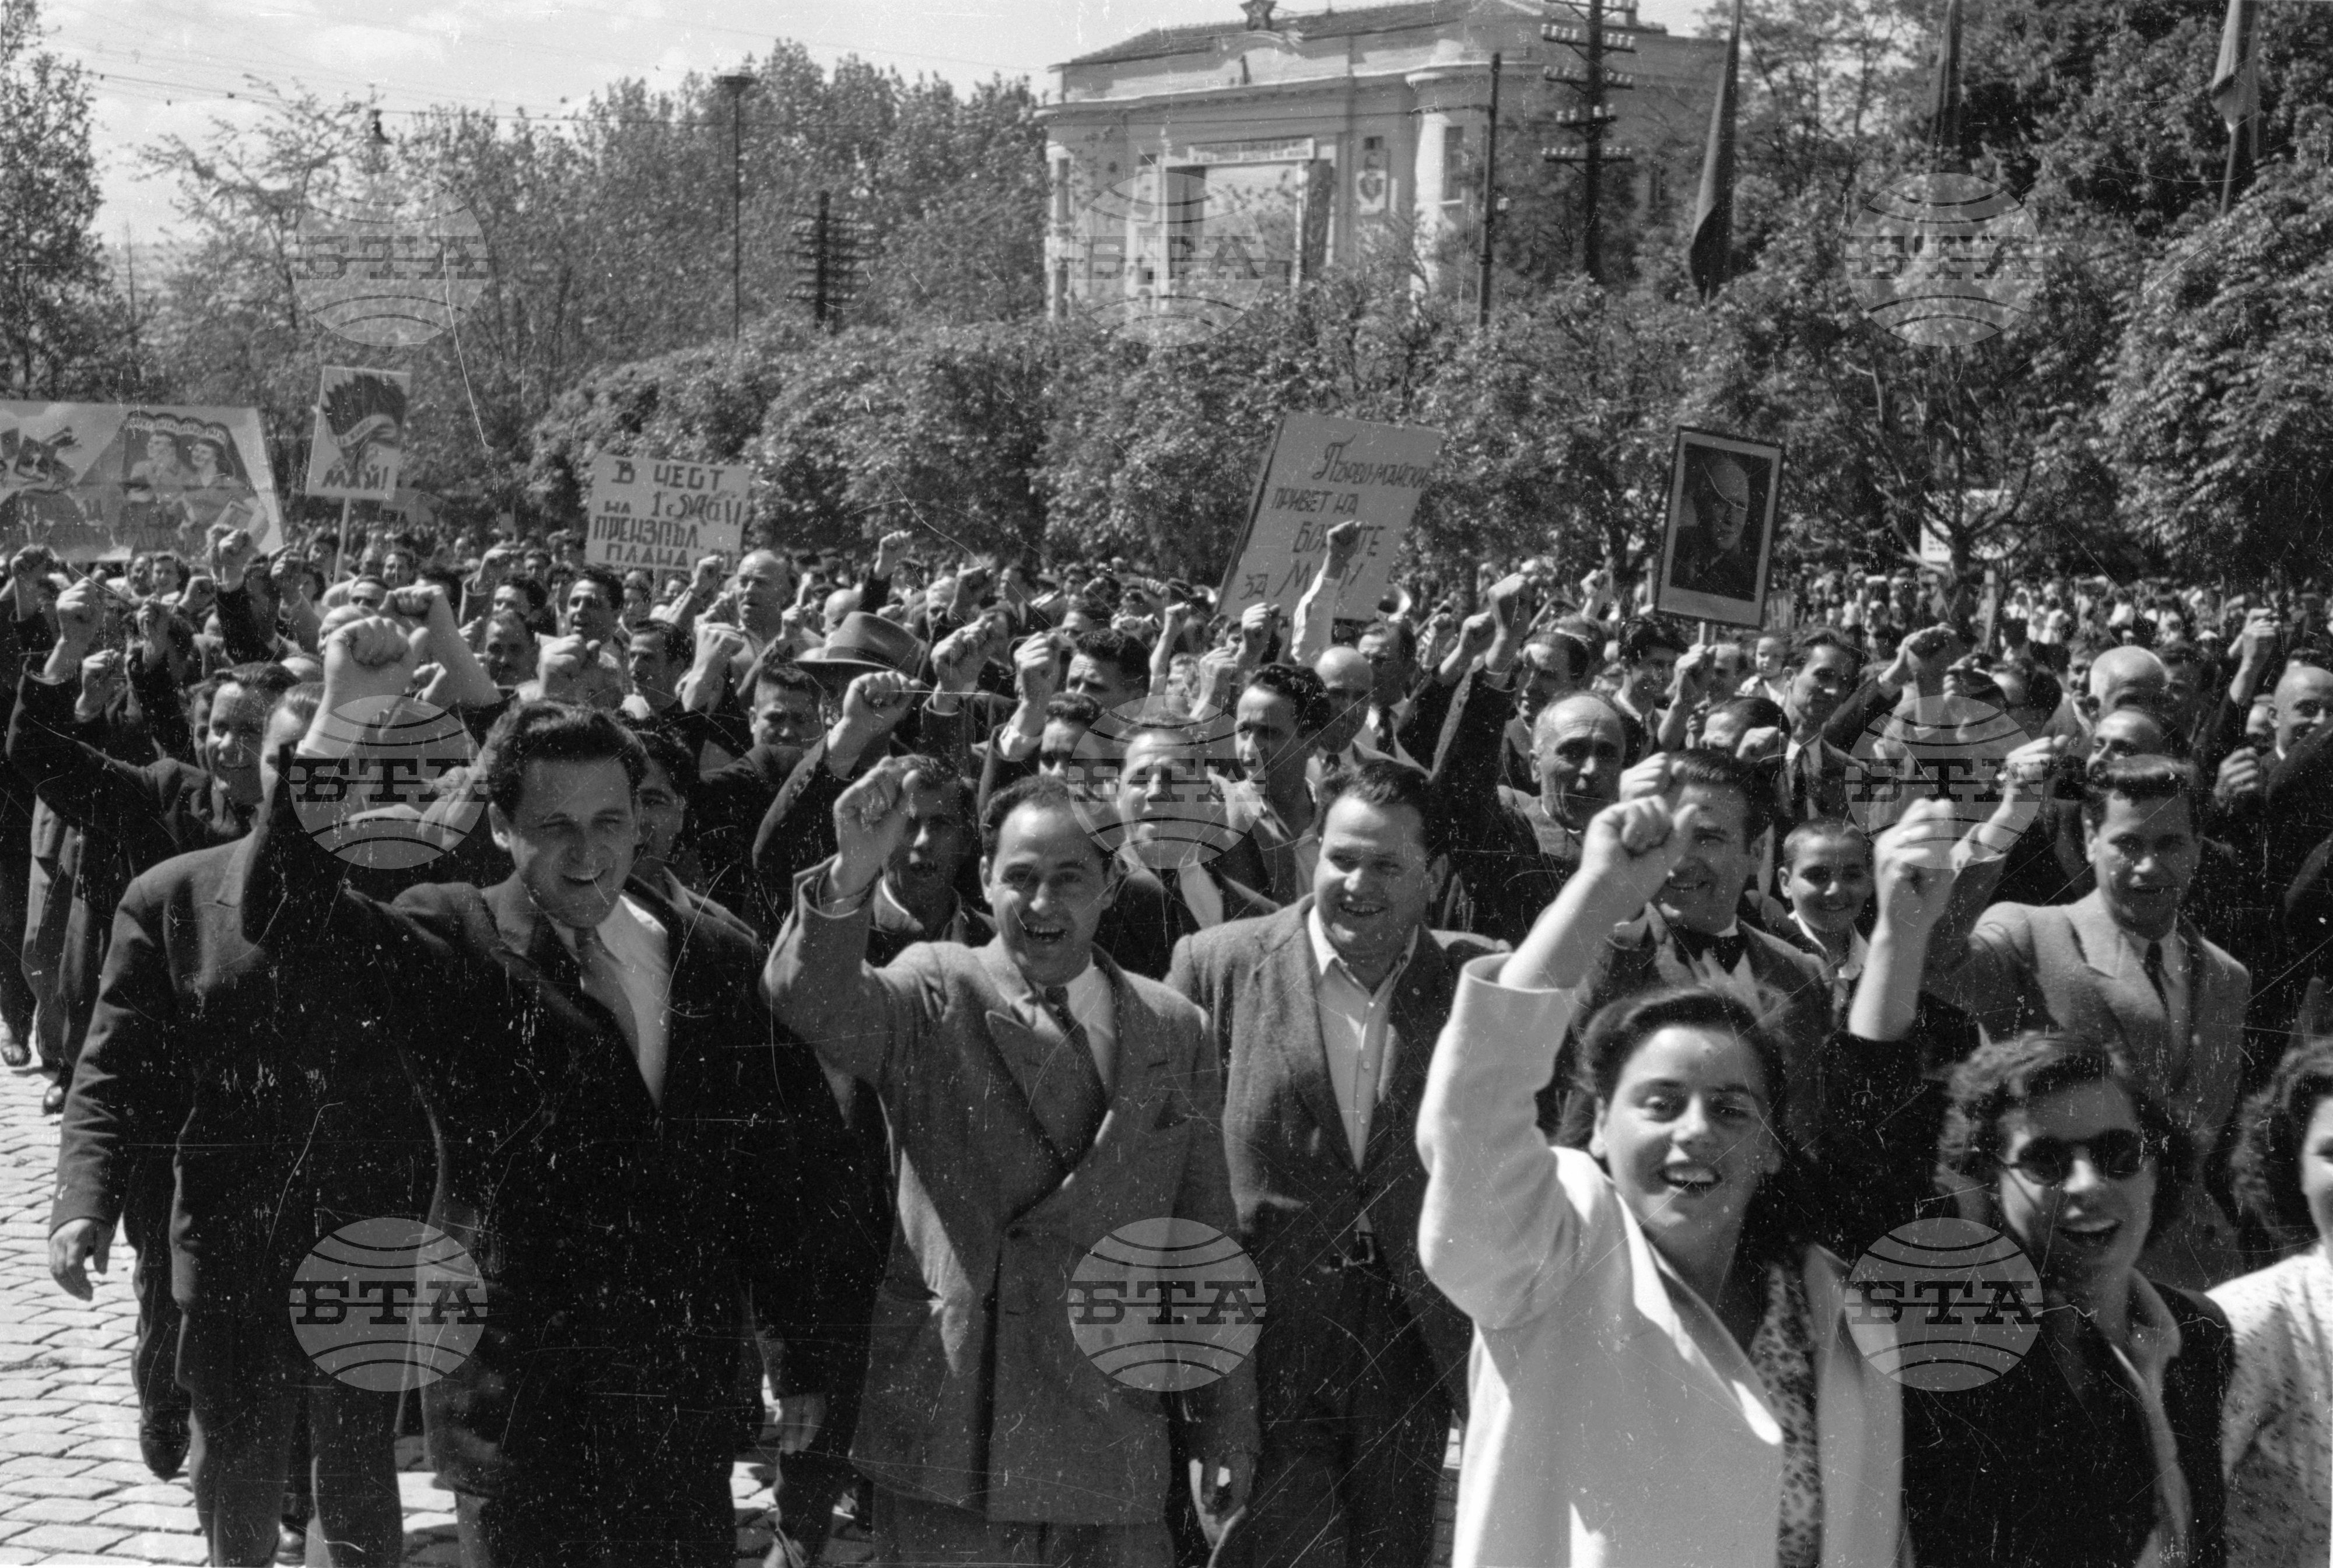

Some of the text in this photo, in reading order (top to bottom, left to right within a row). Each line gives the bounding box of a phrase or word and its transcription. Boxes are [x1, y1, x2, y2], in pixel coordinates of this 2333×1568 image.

[612, 459, 725, 491] В ЧЕСТ
[604, 501, 632, 514] НА
[1270, 487, 1359, 515] ПРИВЕТ НА
[1292, 521, 1386, 556] БОРТЕ
[605, 543, 688, 568] ПЛАНА
[1240, 574, 1269, 599] ЗА
